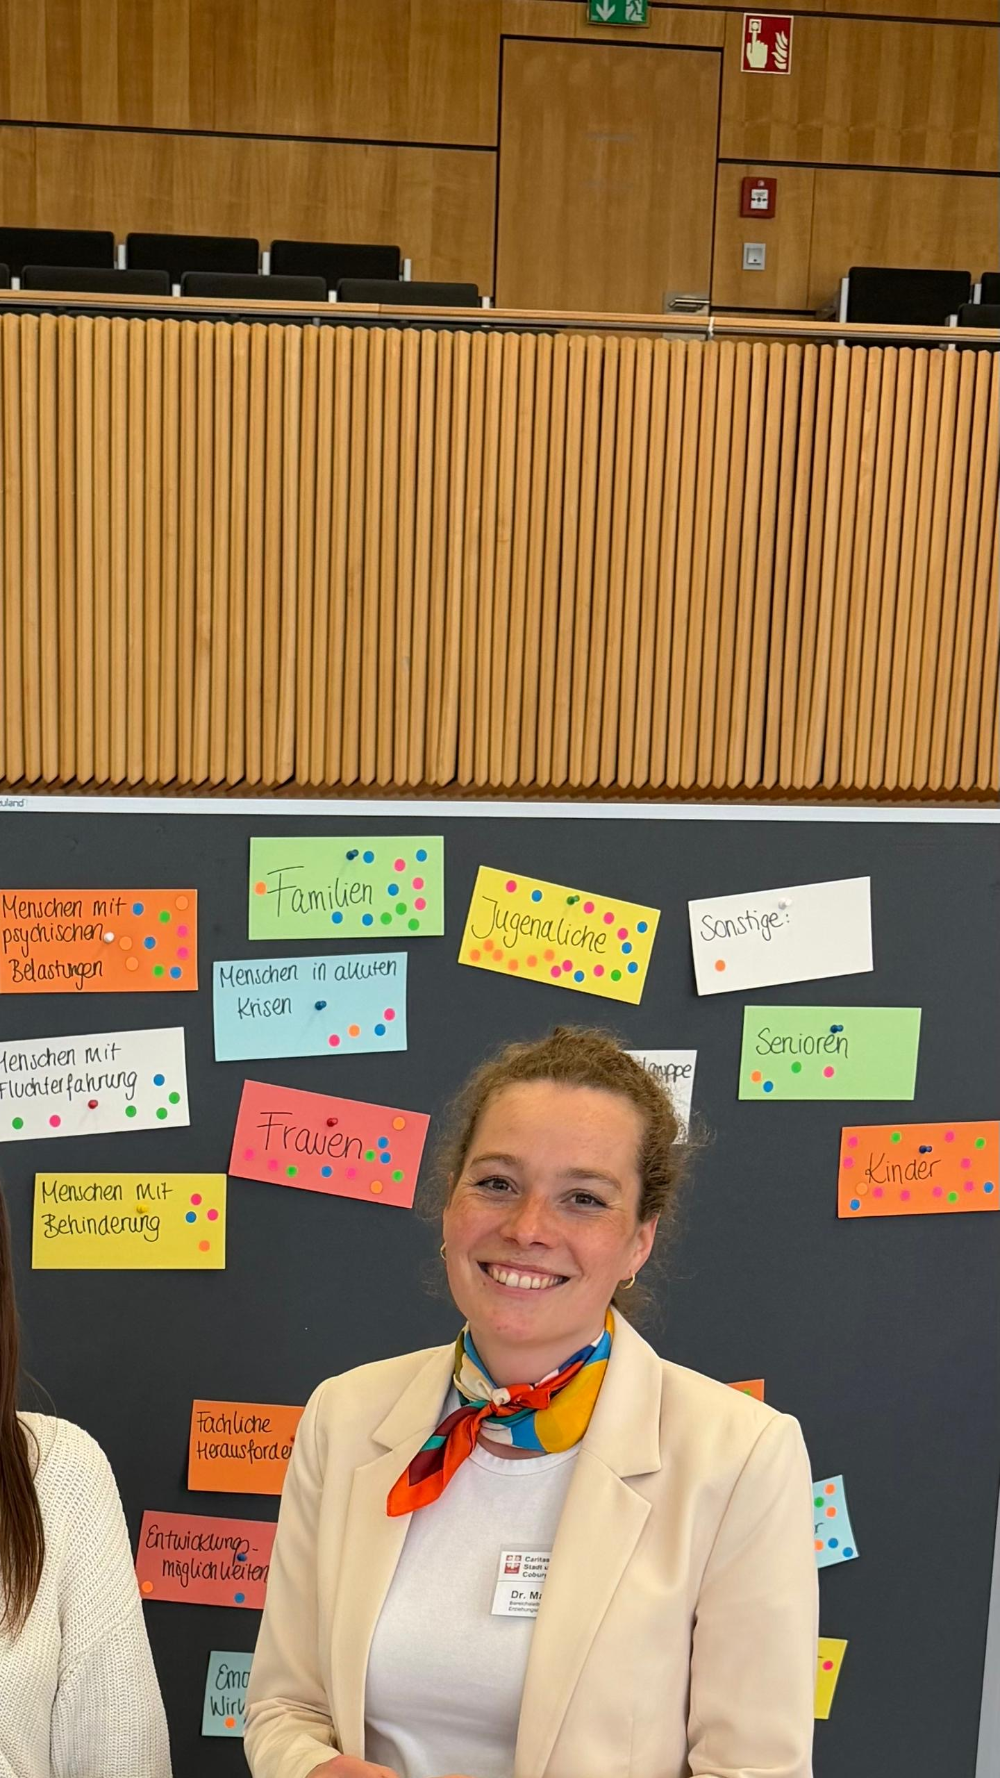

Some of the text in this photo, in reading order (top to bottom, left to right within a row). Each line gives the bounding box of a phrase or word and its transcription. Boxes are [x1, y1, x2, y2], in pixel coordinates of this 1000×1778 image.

[2, 894, 127, 918] Menschen mit
[267, 865, 374, 917] Familien
[2, 922, 105, 956] psychischen
[471, 896, 608, 955] Jugendliche
[700, 908, 792, 942] Sonstige:
[10, 957, 104, 990] Belastungen
[219, 961, 298, 988] Menschen
[312, 961, 327, 980] in
[237, 996, 292, 1020] Krisen
[755, 1026, 849, 1058] Senioren
[257, 1110, 364, 1160] Frauen
[866, 1152, 941, 1184] Kinder
[41, 1181, 123, 1203] Menschen
[42, 1214, 161, 1242] Behinderung
[196, 1410, 273, 1435] Fachliche
[511, 1590, 526, 1599] Dr.
[215, 1664, 249, 1691] Emo
